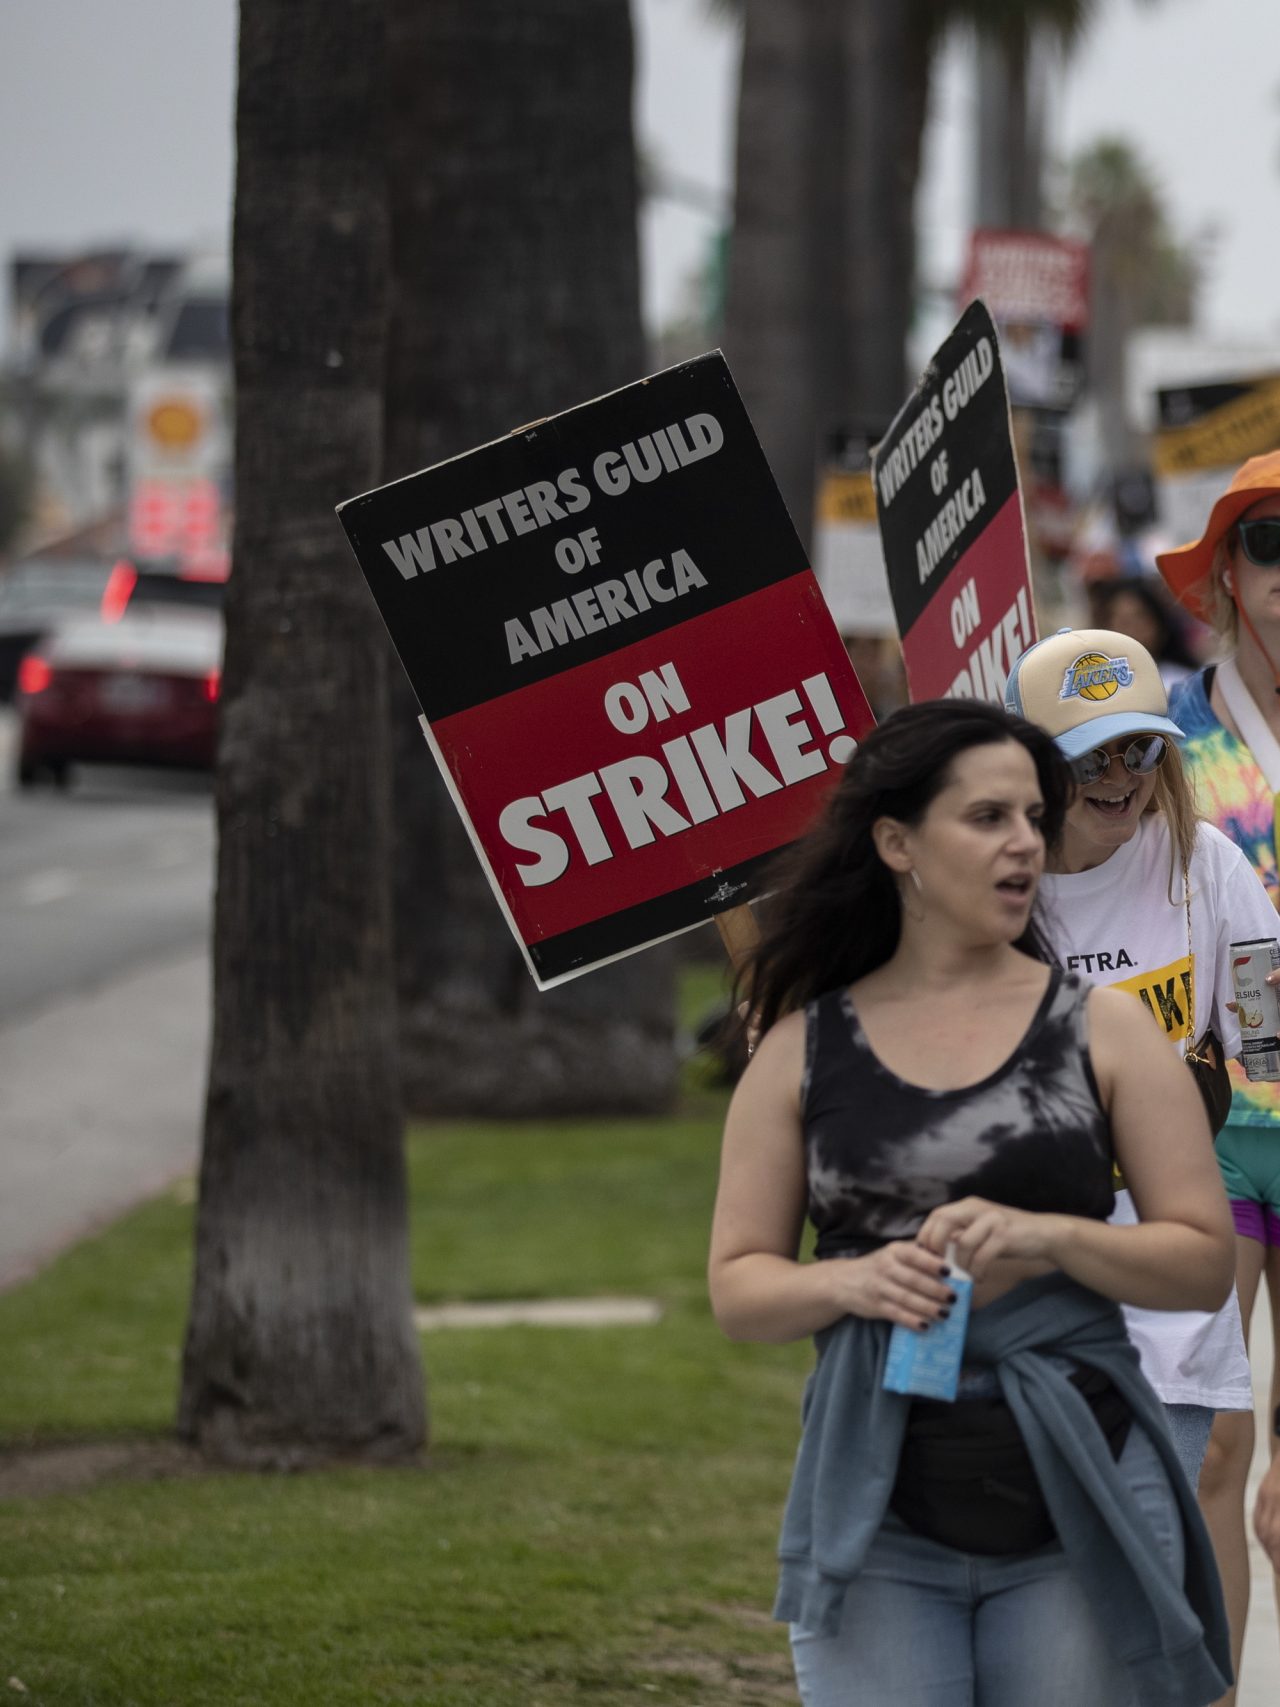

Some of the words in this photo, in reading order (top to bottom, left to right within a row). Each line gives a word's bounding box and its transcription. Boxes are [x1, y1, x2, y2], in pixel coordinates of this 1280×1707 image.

[878, 394, 944, 508] WRITERS
[942, 337, 994, 421] GUILD
[381, 467, 592, 581] WRITERS
[592, 412, 725, 497] GUILD
[929, 449, 949, 497] OF
[554, 526, 603, 575] OF
[916, 467, 986, 585] AMERICA
[503, 548, 709, 665] AMERICA
[950, 577, 982, 649] ON
[603, 660, 693, 735] ON
[1060, 663, 1135, 700] LAKERS
[498, 671, 859, 888] STRIKE!
